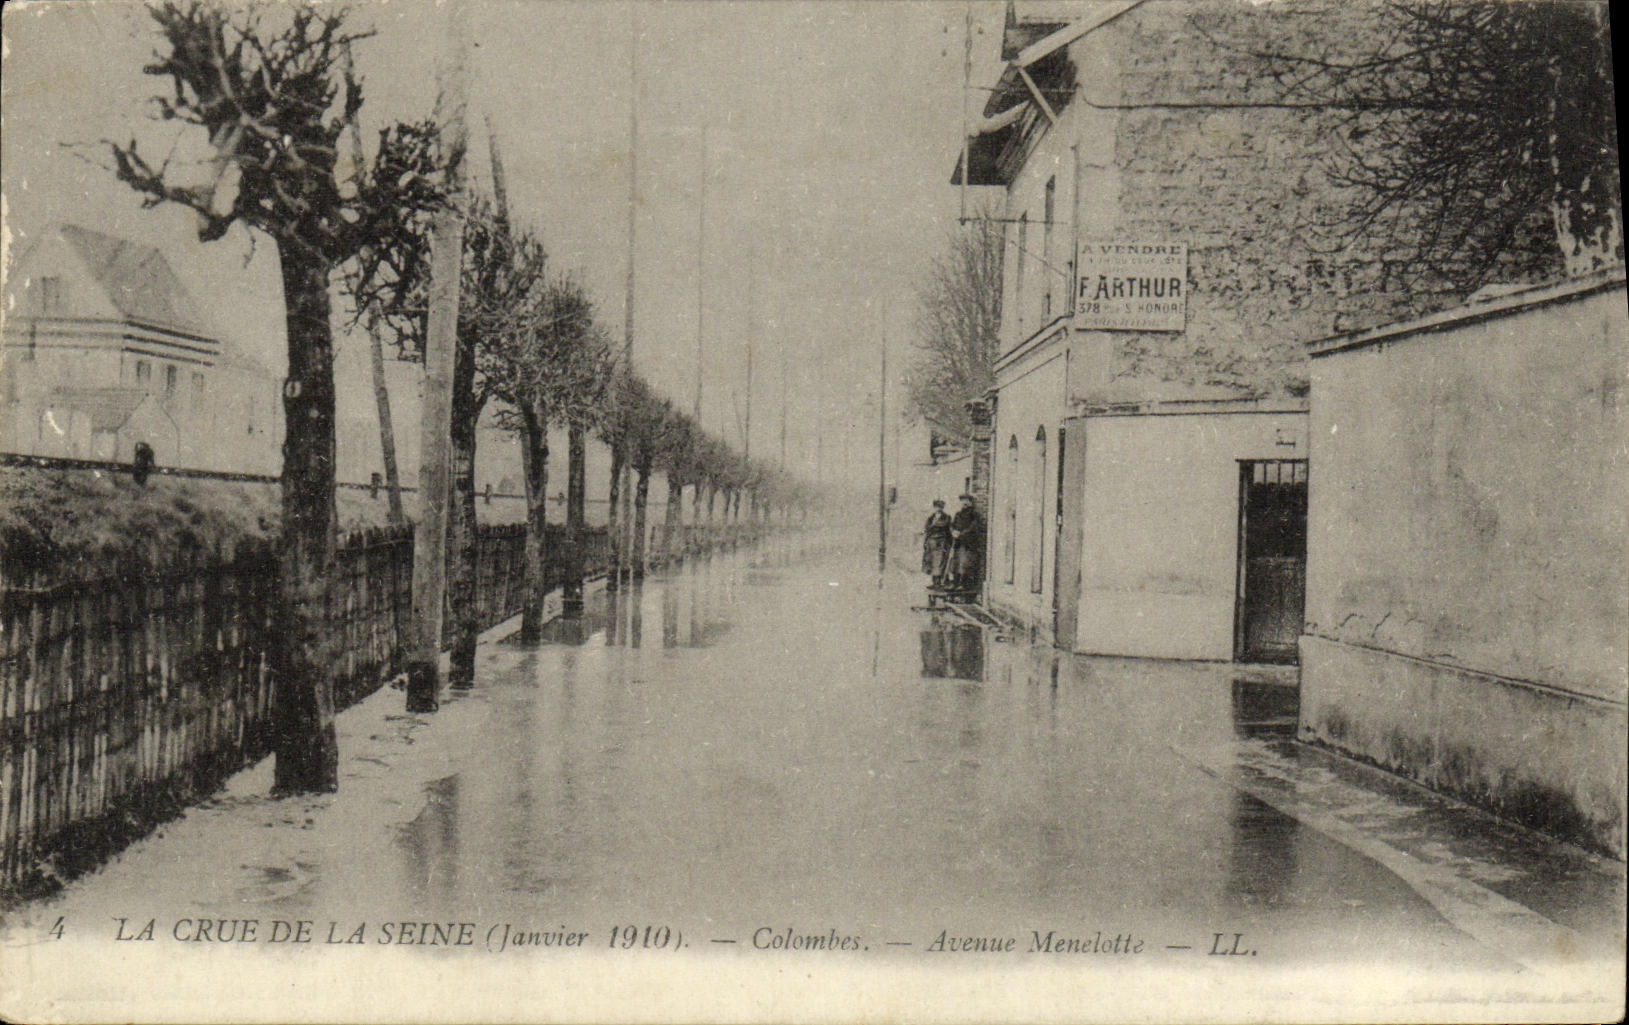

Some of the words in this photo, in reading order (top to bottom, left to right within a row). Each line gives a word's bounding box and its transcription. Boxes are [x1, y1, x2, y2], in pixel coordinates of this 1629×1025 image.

[1082, 245, 1092, 254] A
[1101, 245, 1181, 255] VENDRE
[1079, 302, 1100, 314] 378
